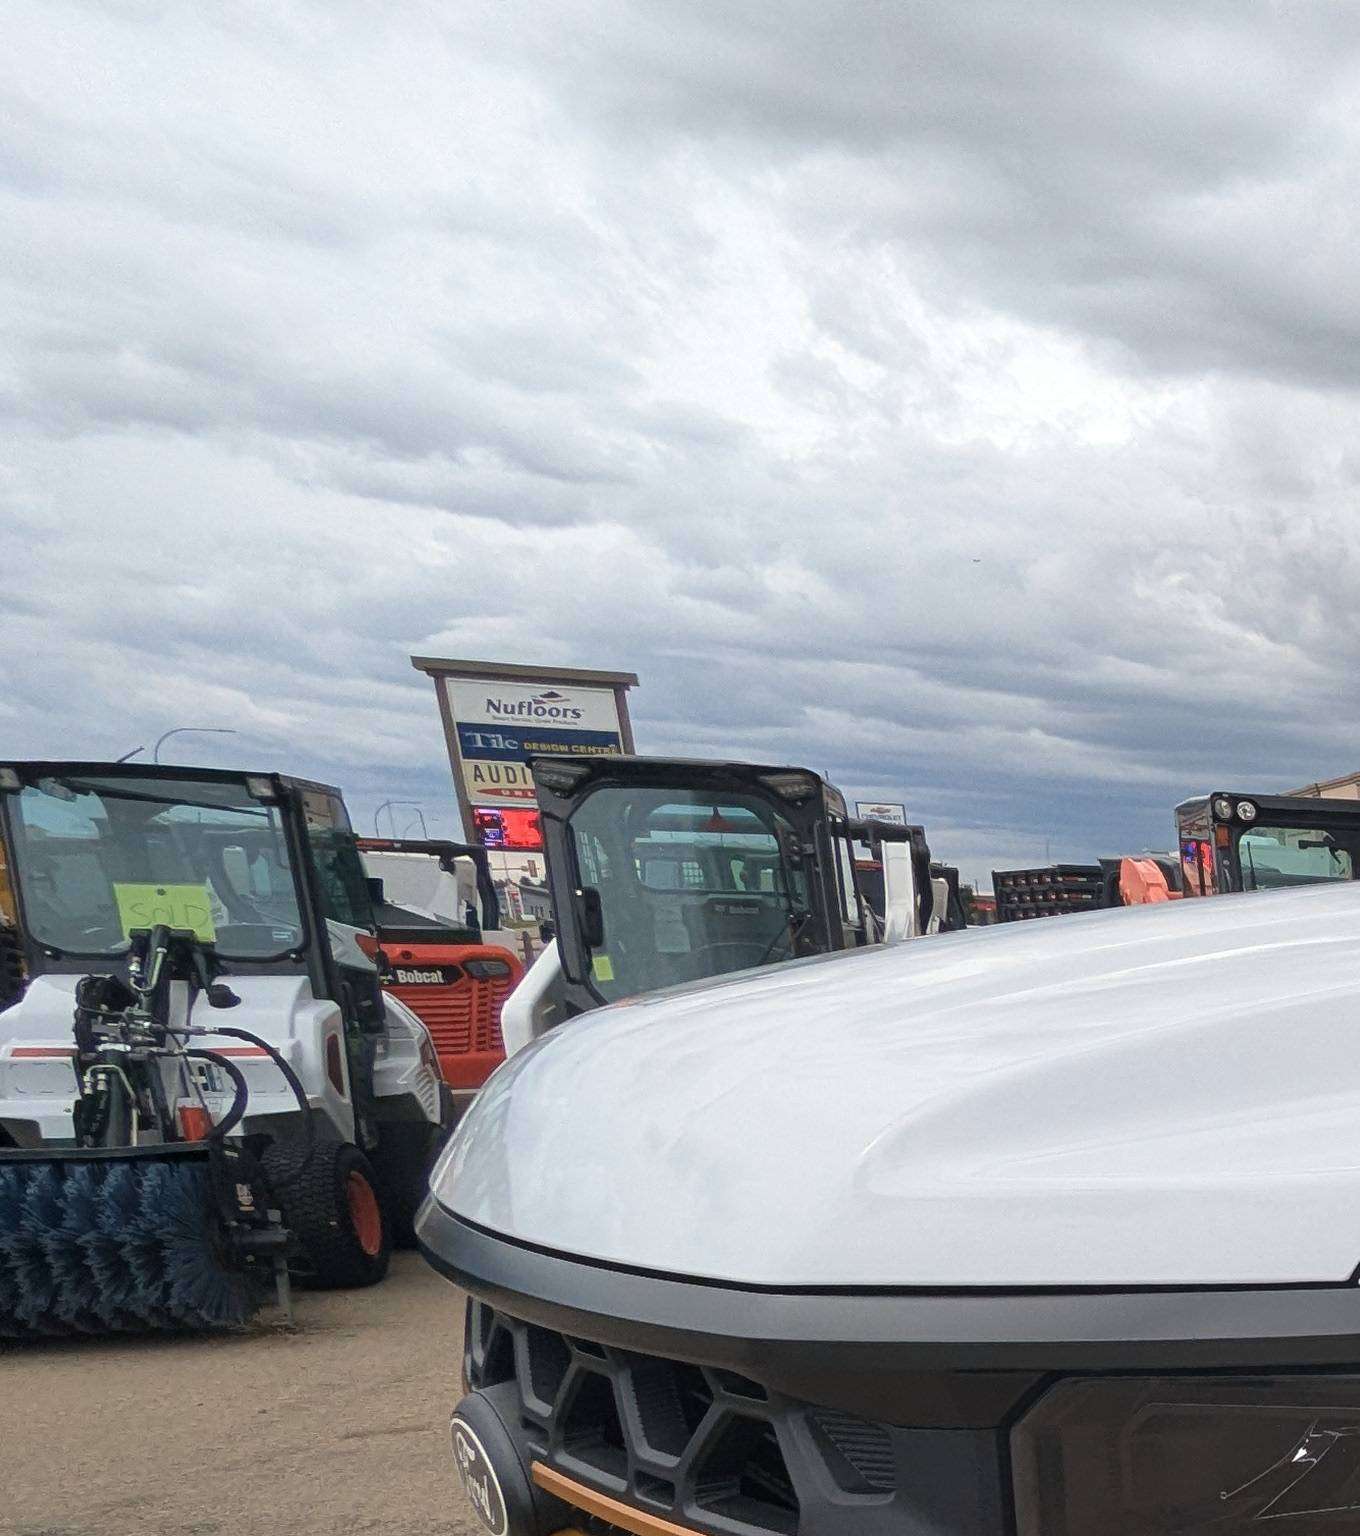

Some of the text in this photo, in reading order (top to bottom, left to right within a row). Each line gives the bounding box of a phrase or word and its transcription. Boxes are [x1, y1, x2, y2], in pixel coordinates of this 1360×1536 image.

[486, 698, 581, 719] Nufloors
[473, 764, 528, 785] AUDI
[130, 902, 209, 928] SOLD
[396, 969, 444, 984] Bobcat
[456, 1431, 496, 1526] Ford
